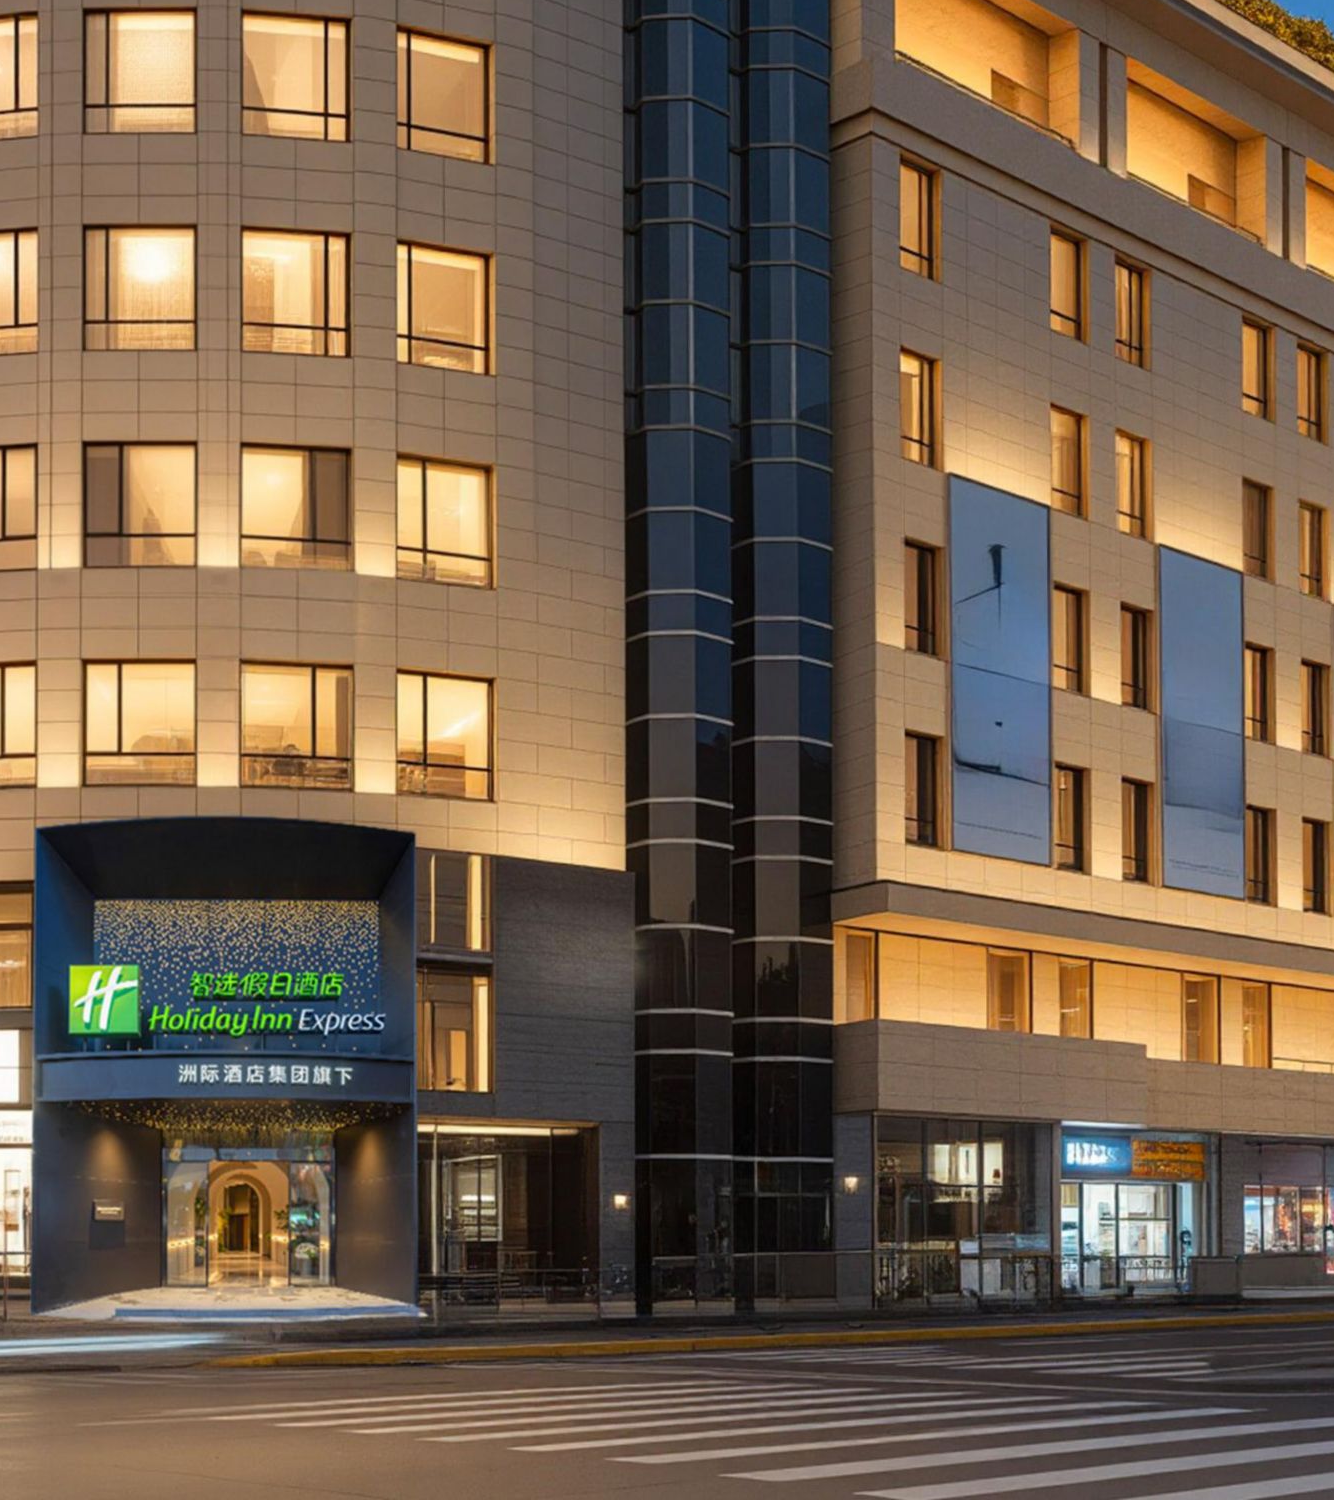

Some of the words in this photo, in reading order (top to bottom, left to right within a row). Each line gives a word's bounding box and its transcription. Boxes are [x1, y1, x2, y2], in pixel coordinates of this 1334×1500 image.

[189, 971, 345, 997] 智选假日酒店
[148, 1004, 248, 1037] Holiday
[252, 1004, 293, 1031] Inn
[298, 1008, 387, 1036] Express
[178, 1063, 354, 1086] 洲际酒店集团旗下
